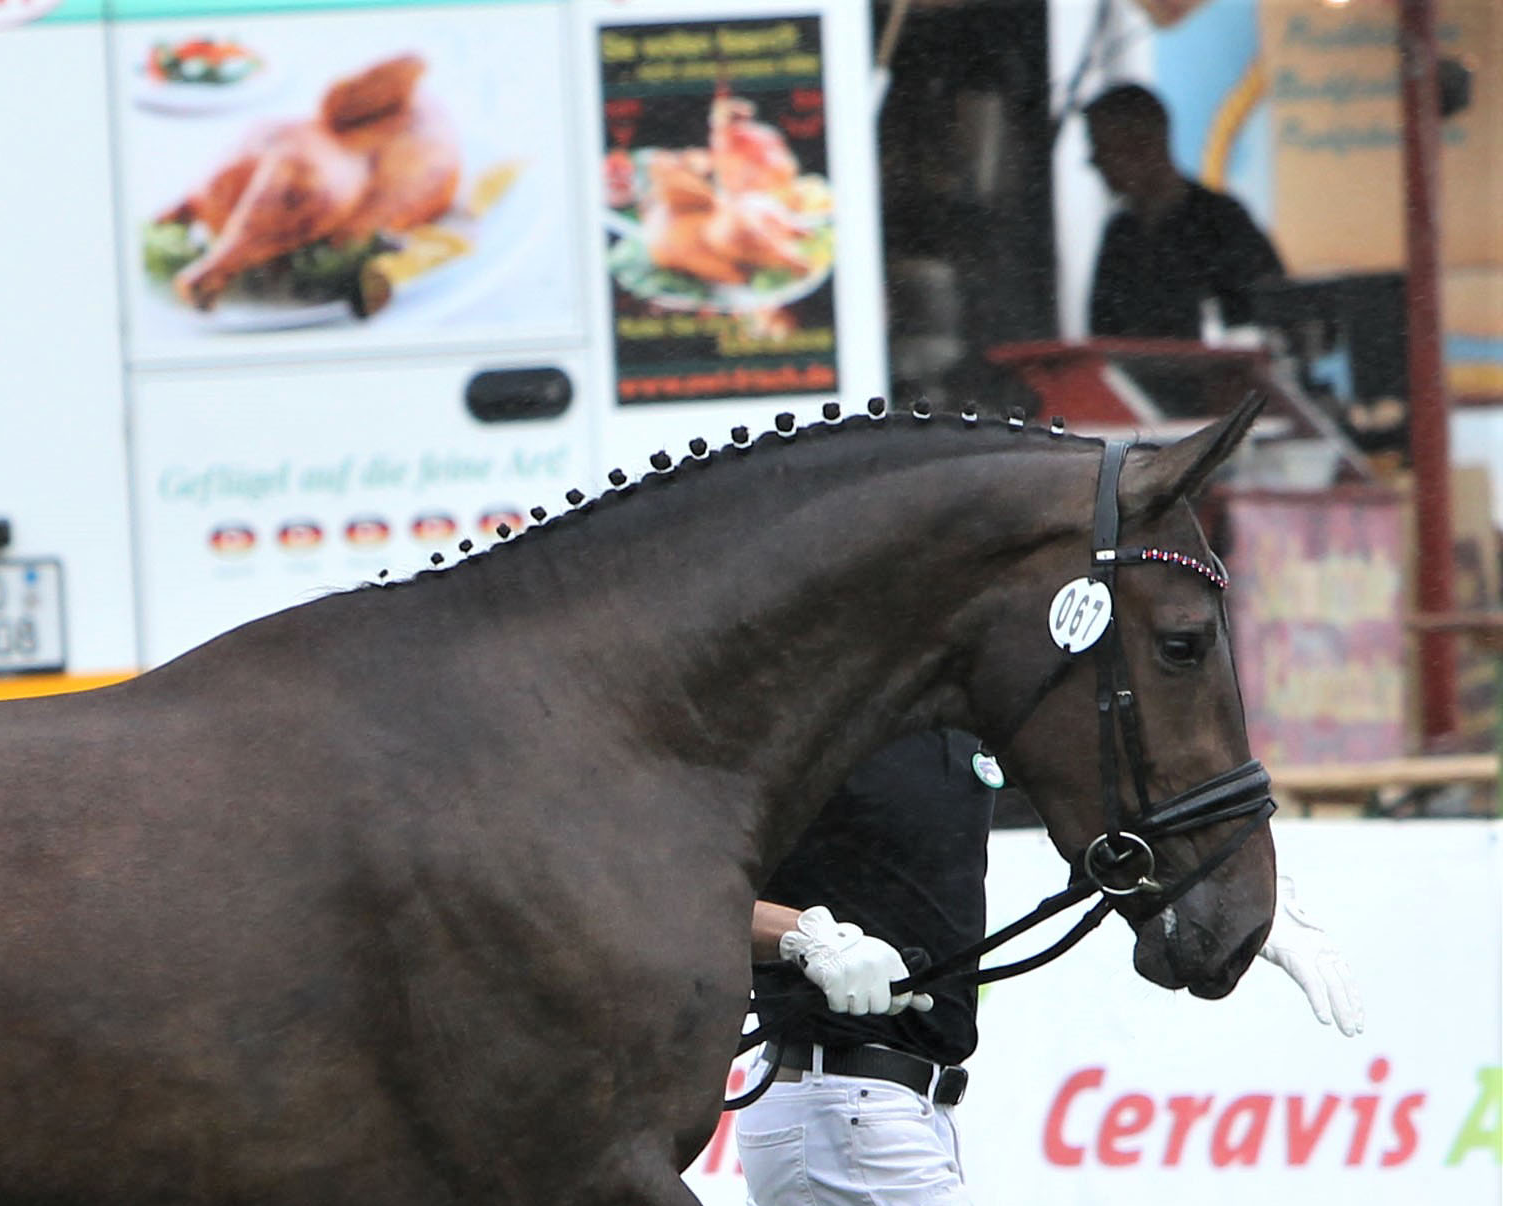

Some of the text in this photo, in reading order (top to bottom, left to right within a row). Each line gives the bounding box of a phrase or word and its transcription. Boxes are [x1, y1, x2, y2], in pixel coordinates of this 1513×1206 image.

[298, 457, 356, 498] auf
[360, 452, 409, 490] die
[1055, 587, 1104, 642] 067
[1041, 1057, 1426, 1168] Ceravis
